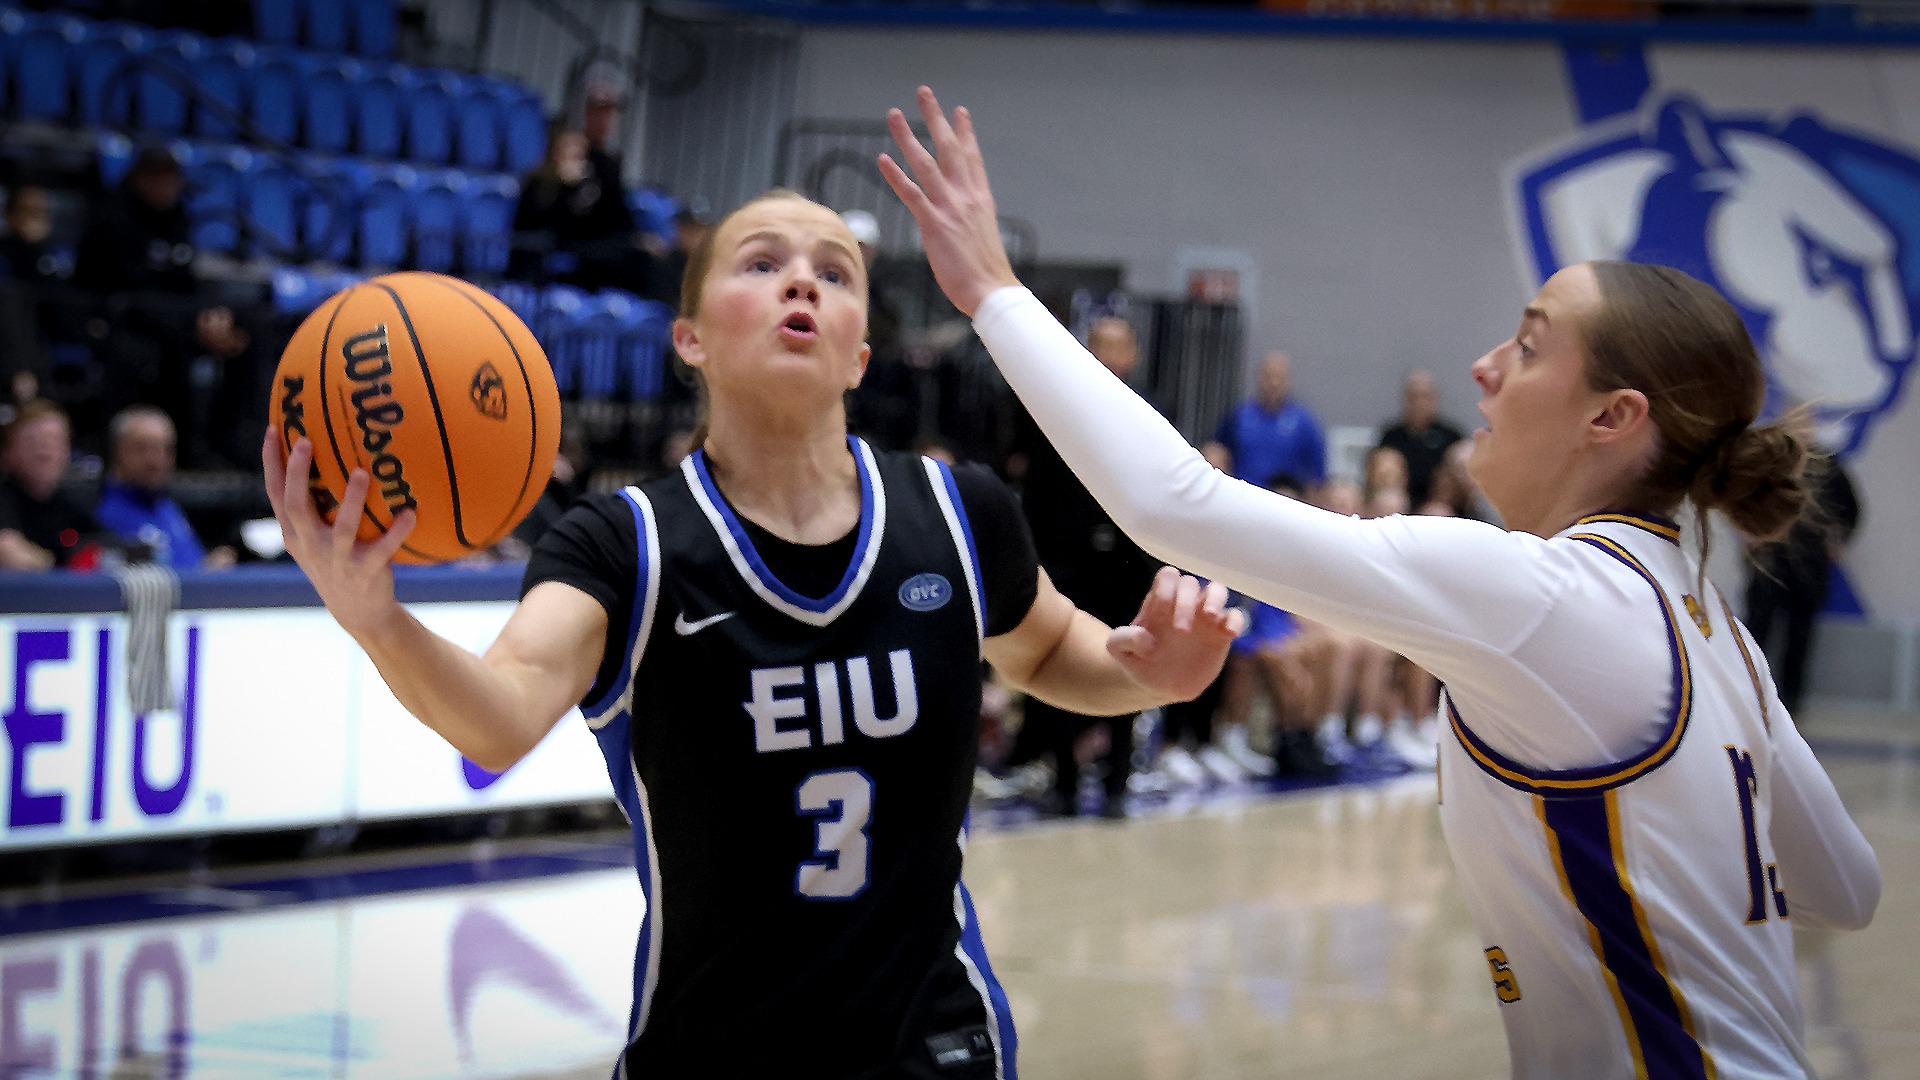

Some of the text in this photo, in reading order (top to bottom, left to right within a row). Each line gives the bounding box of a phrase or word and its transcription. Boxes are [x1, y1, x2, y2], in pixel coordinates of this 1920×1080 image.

[281, 374, 340, 514] NCA
[342, 323, 417, 516] Wilson
[1, 626, 200, 829] EIU
[741, 648, 919, 753] EIU
[793, 766, 876, 901] 3
